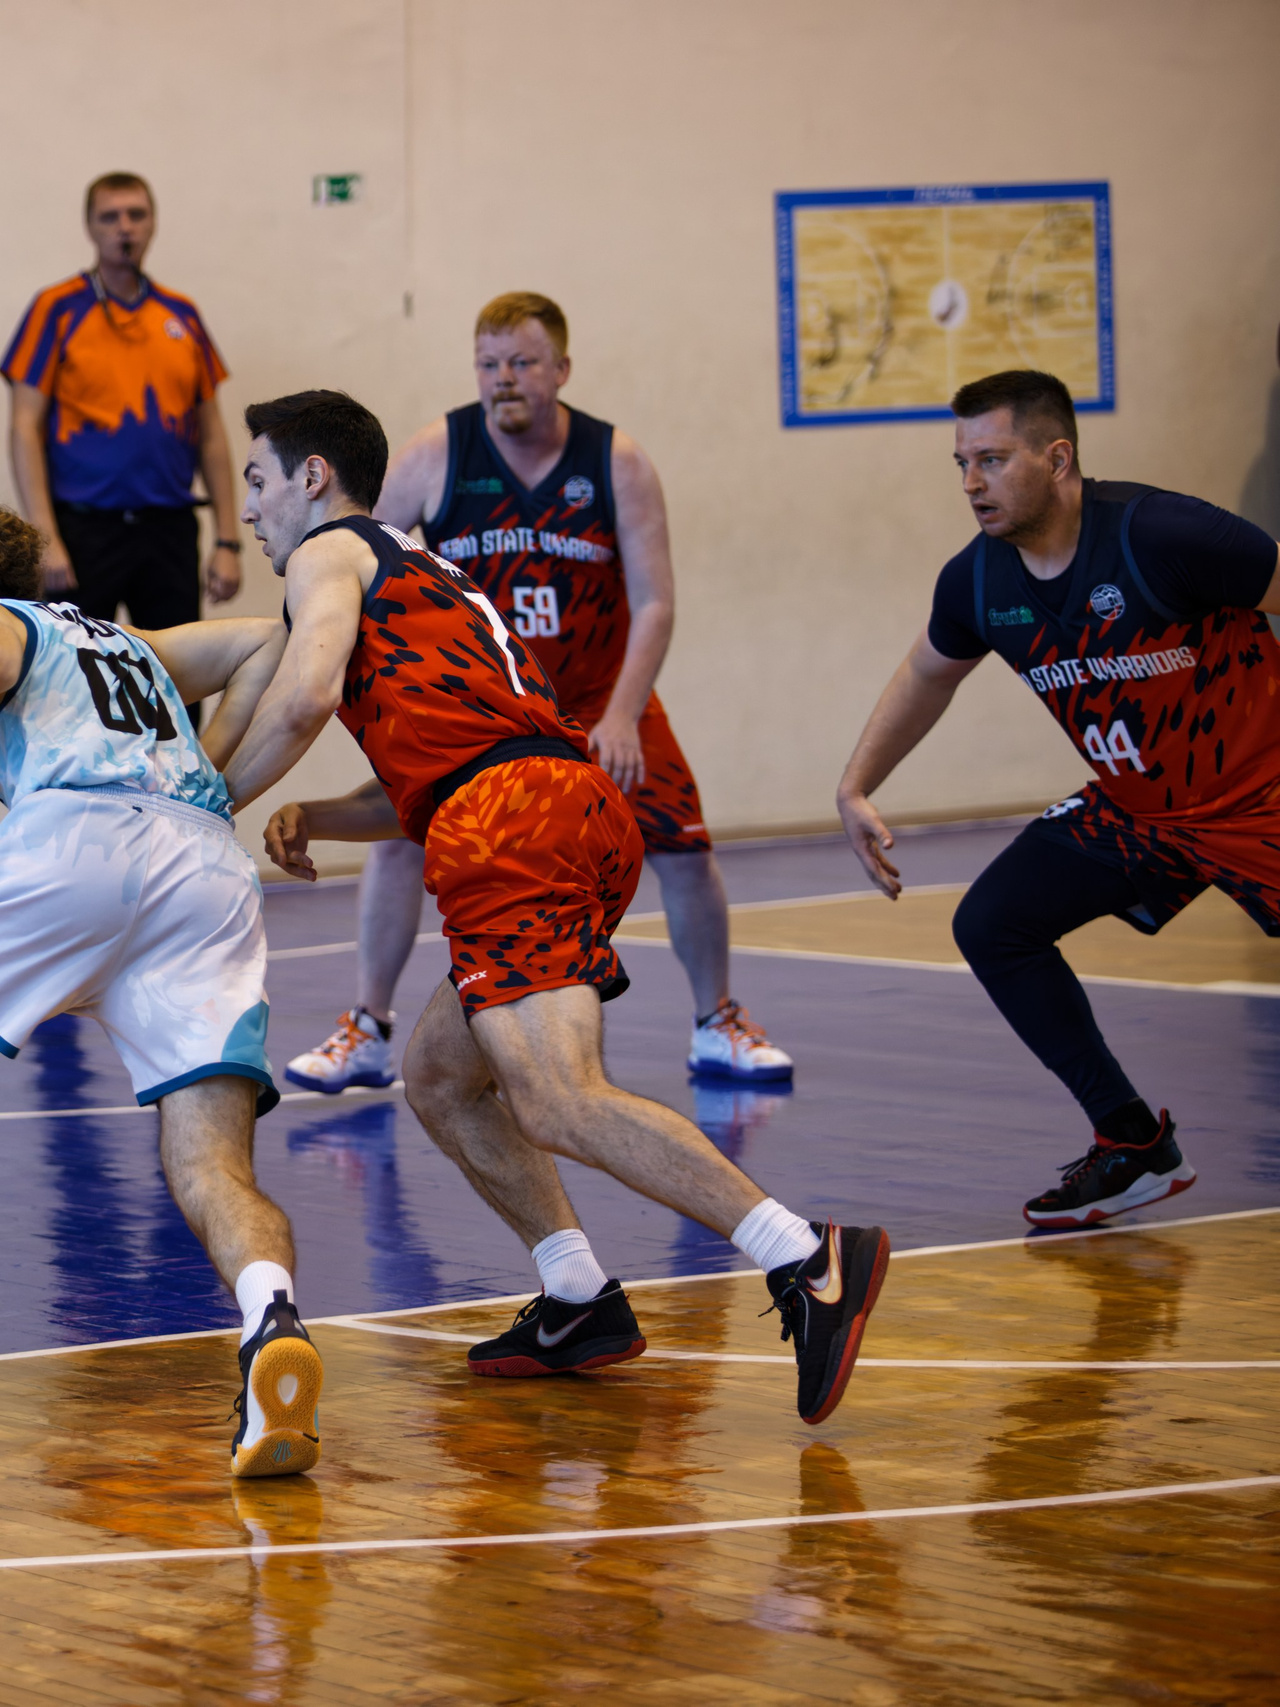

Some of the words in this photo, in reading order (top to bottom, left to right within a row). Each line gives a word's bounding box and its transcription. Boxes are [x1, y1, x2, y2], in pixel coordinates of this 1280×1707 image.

[482, 526, 536, 556] STATE
[512, 585, 560, 638] 59
[77, 648, 177, 741] 00
[1029, 658, 1088, 693] STATE
[1085, 646, 1196, 682] WARRIORS
[1083, 719, 1147, 776] 44
